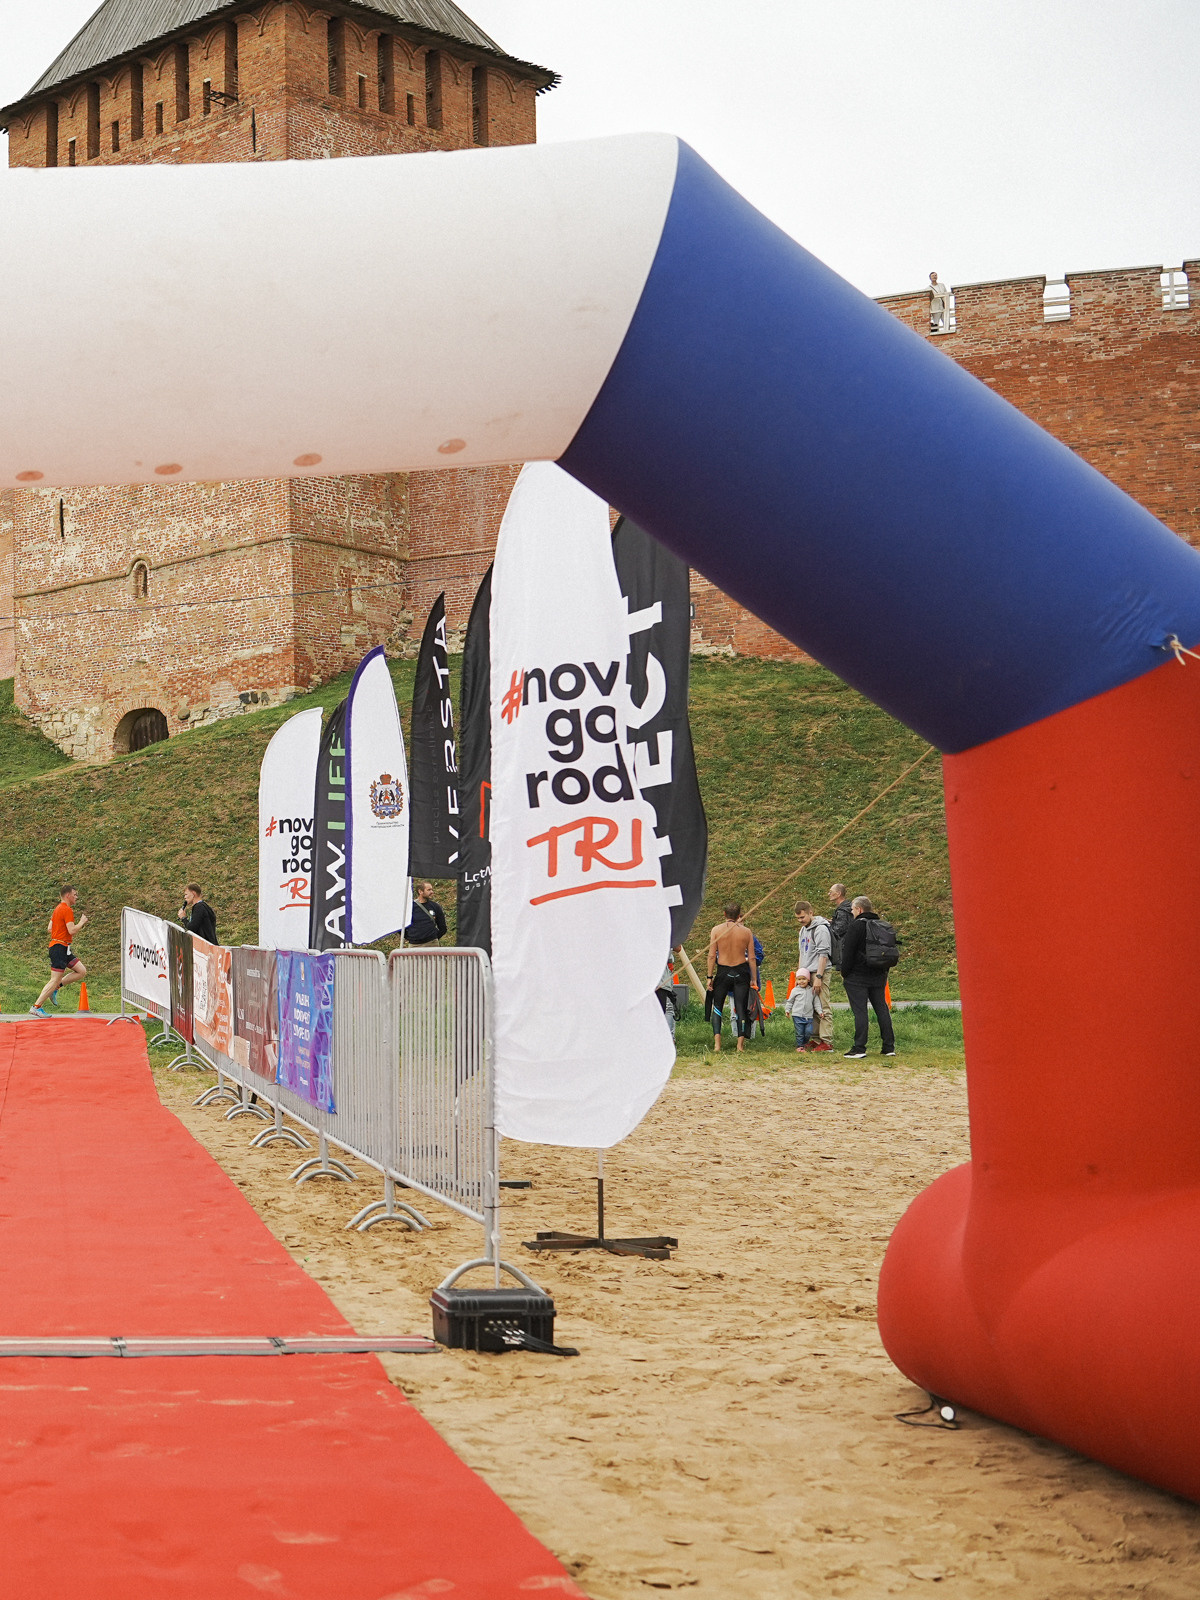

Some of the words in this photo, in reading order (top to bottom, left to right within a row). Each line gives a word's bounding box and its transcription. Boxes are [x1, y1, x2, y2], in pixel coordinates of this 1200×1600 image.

[501, 660, 621, 725] #nov
[545, 705, 618, 763] go
[526, 743, 635, 809] rod
[526, 816, 643, 878] TRI
